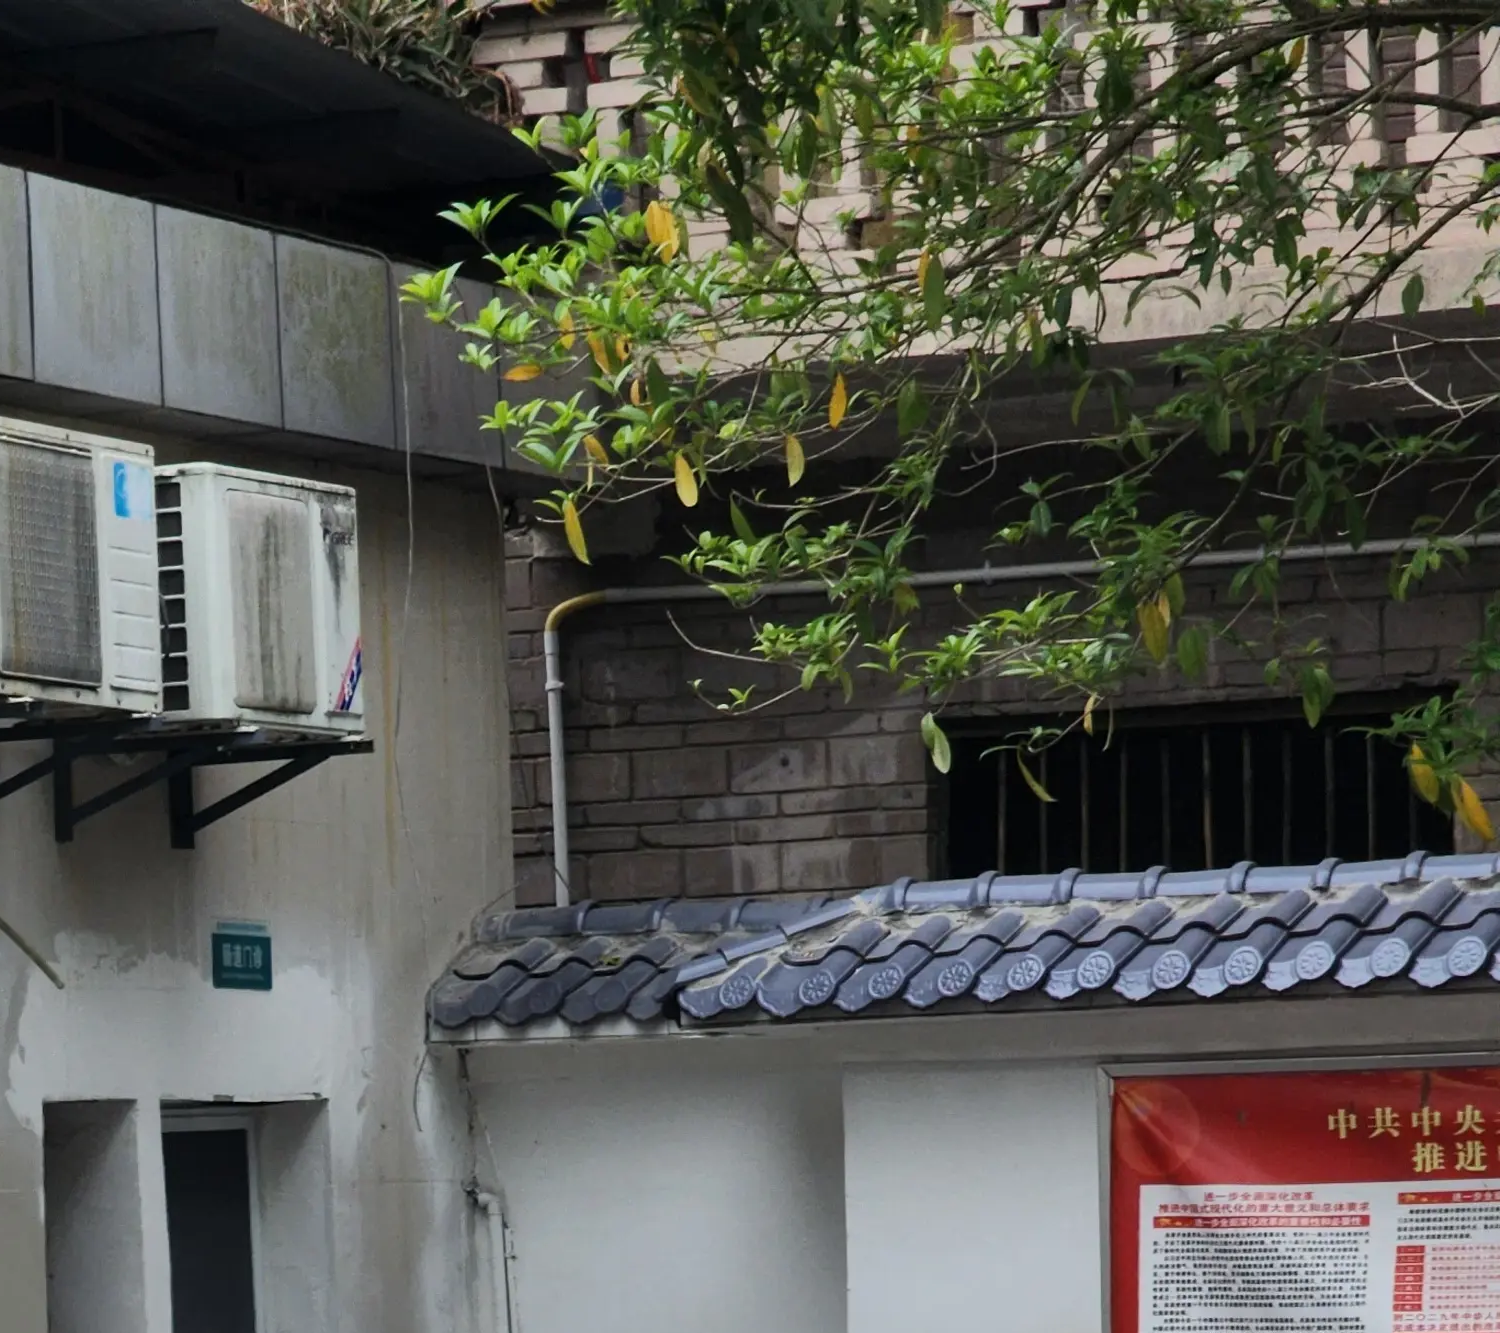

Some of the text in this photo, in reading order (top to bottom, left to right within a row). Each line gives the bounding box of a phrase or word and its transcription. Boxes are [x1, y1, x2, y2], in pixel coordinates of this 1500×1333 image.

[1328, 1104, 1500, 1139] 中共中央
[1412, 1140, 1500, 1173] 推进
